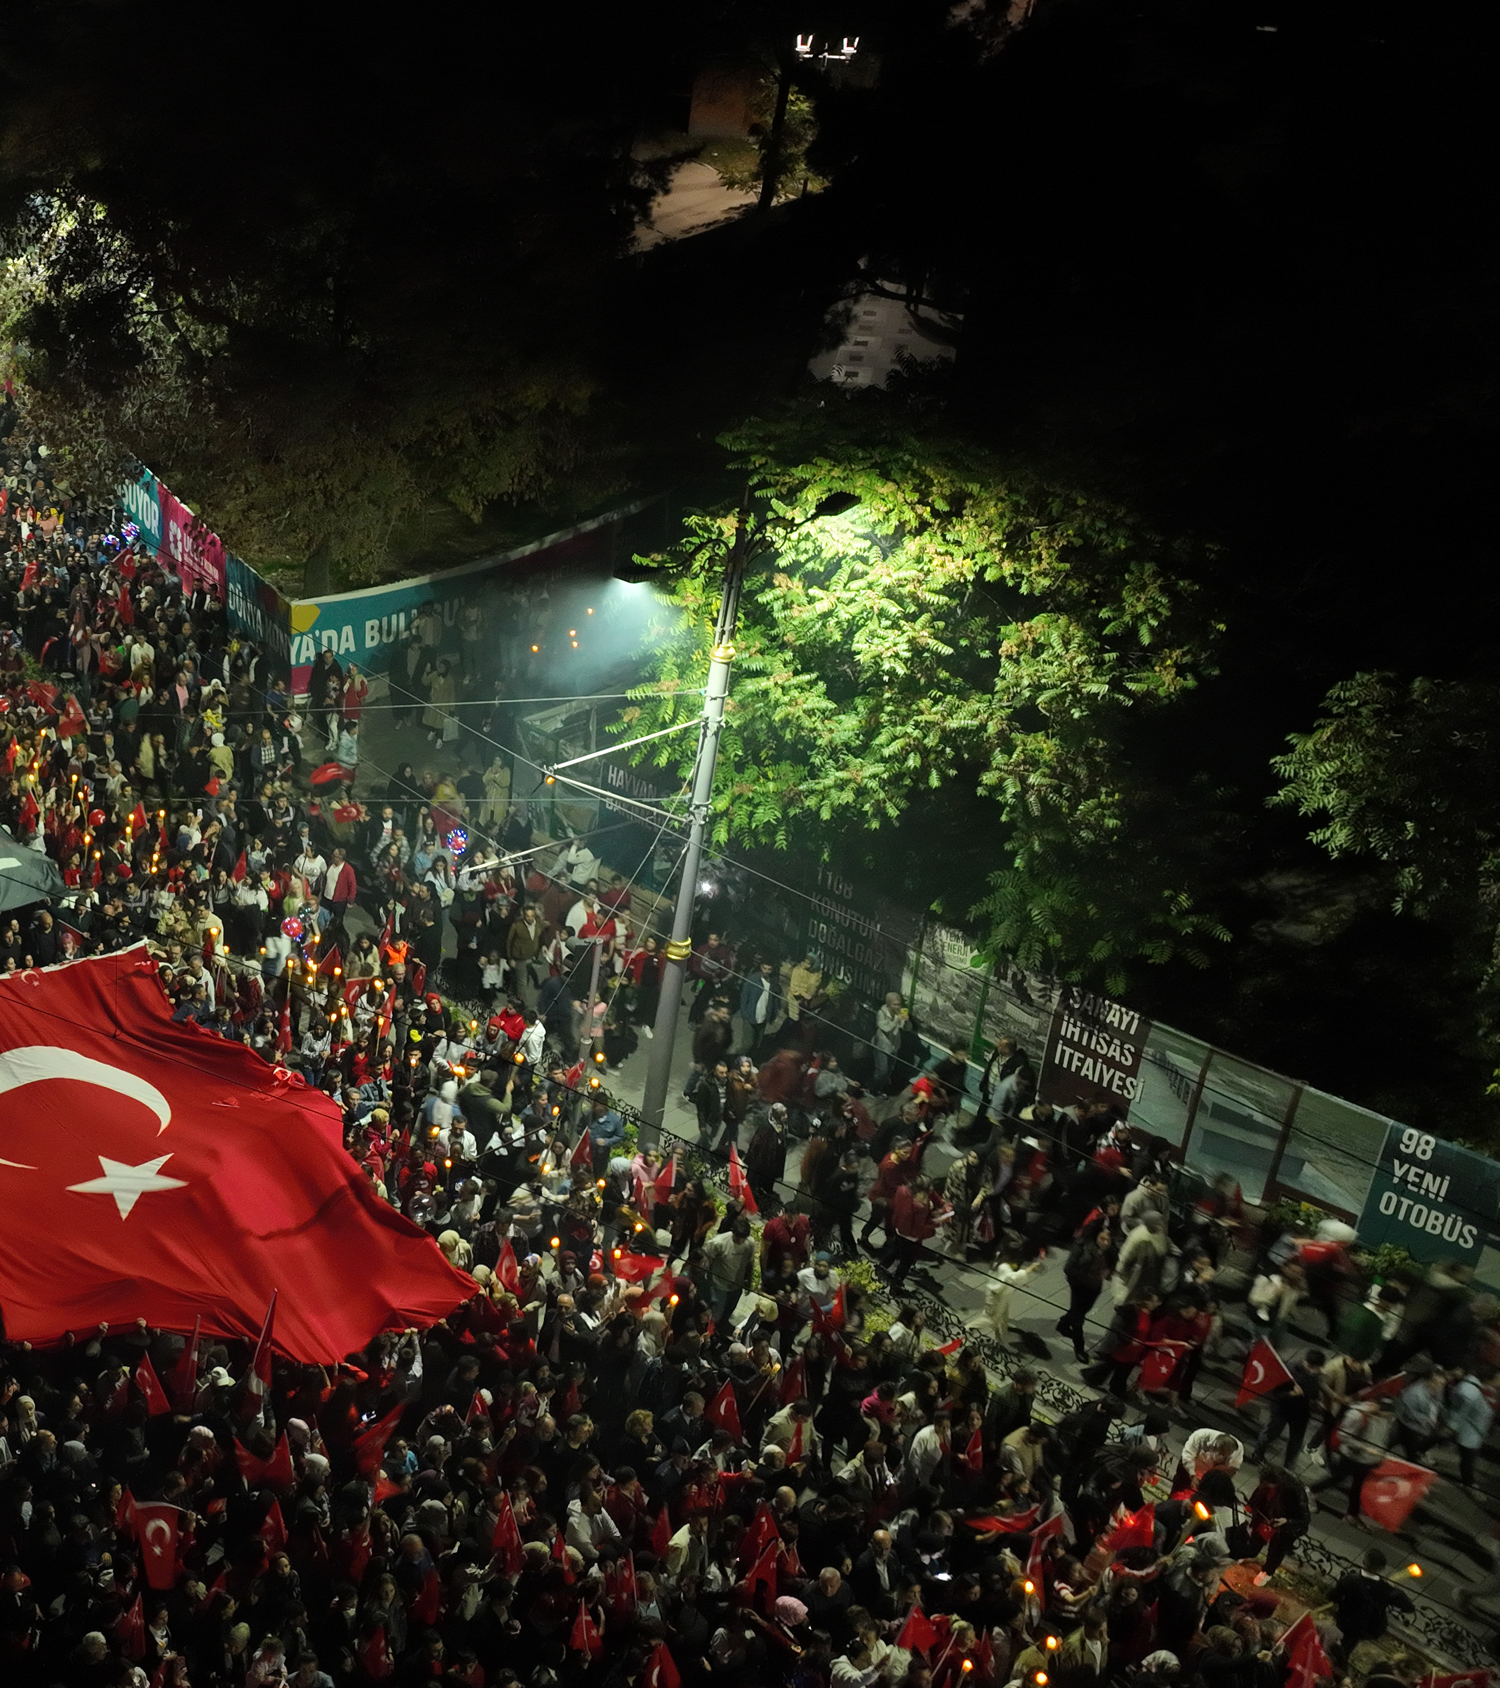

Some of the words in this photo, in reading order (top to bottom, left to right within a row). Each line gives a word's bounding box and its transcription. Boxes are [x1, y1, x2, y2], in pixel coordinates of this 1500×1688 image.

[1054, 1039, 1145, 1104] İTFAİYESİ
[1399, 1128, 1436, 1161] 98
[1392, 1158, 1451, 1203] YENİ
[1378, 1191, 1478, 1249] OTOBÜS
